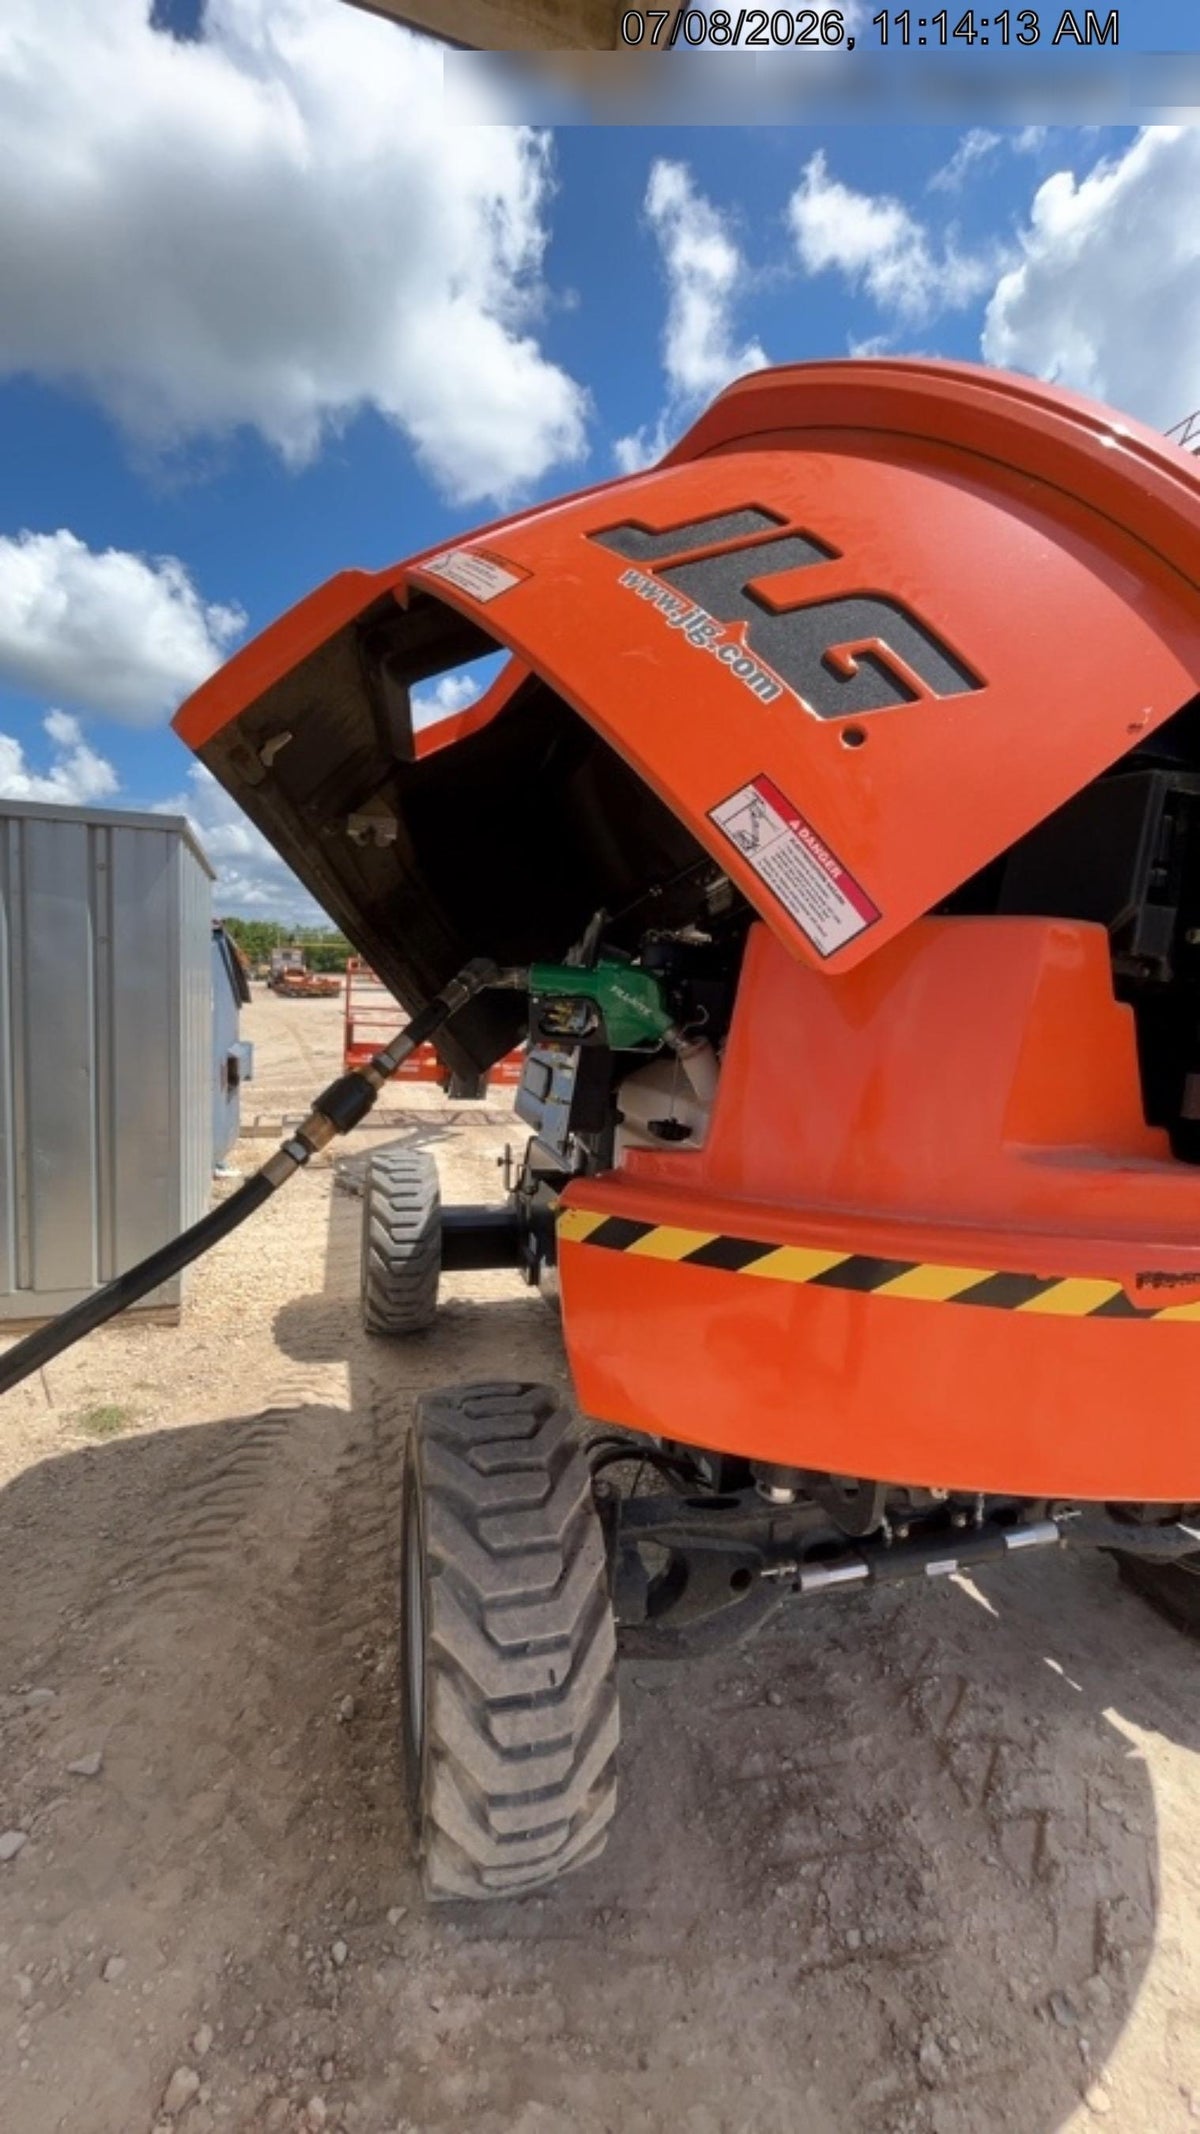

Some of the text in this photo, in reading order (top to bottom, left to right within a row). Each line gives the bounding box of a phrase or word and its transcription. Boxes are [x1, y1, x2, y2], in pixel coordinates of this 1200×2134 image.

[584, 502, 986, 720] JLG
[618, 568, 783, 704] www.jlg.com
[798, 828, 844, 879] DANGER
